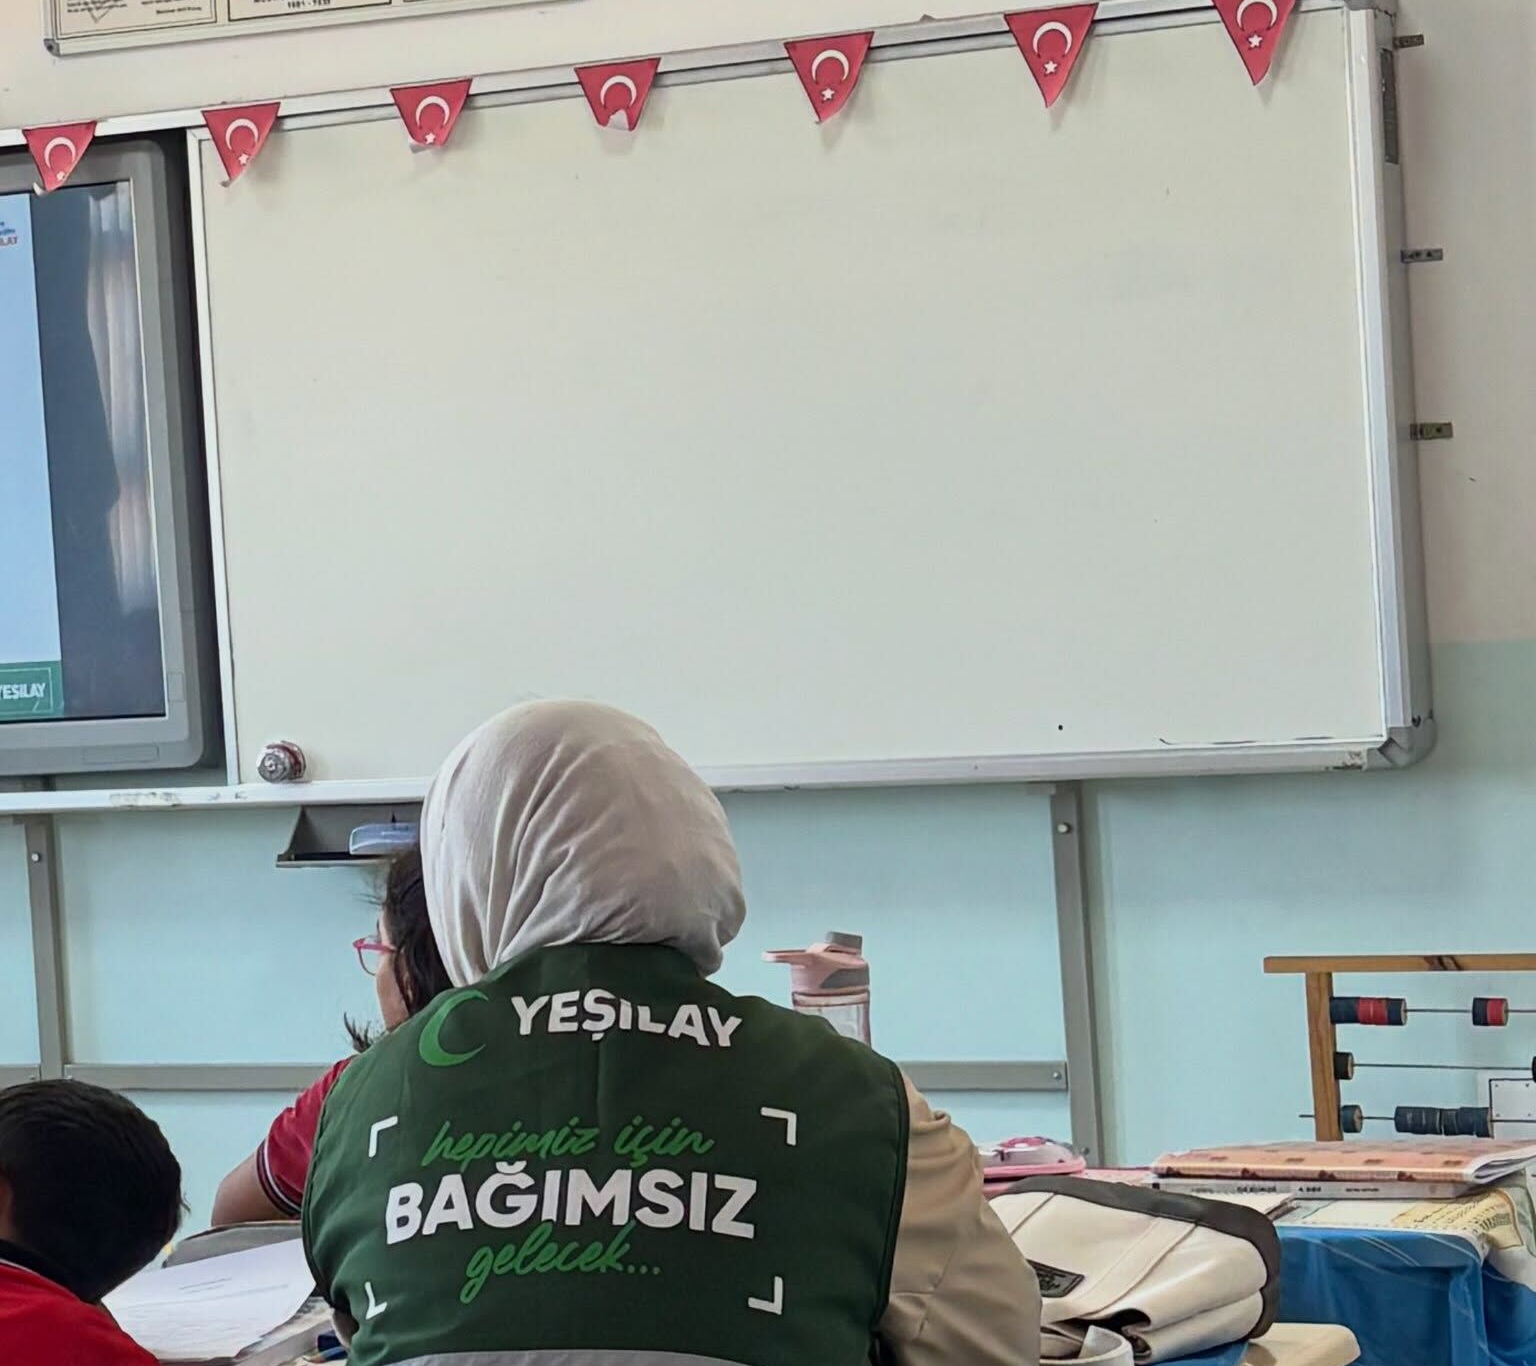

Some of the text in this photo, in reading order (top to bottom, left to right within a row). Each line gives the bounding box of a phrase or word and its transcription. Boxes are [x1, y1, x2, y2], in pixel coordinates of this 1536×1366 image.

[421, 1114, 715, 1173] hepimiz için
[385, 1160, 758, 1246] BAĞIMSIZ
